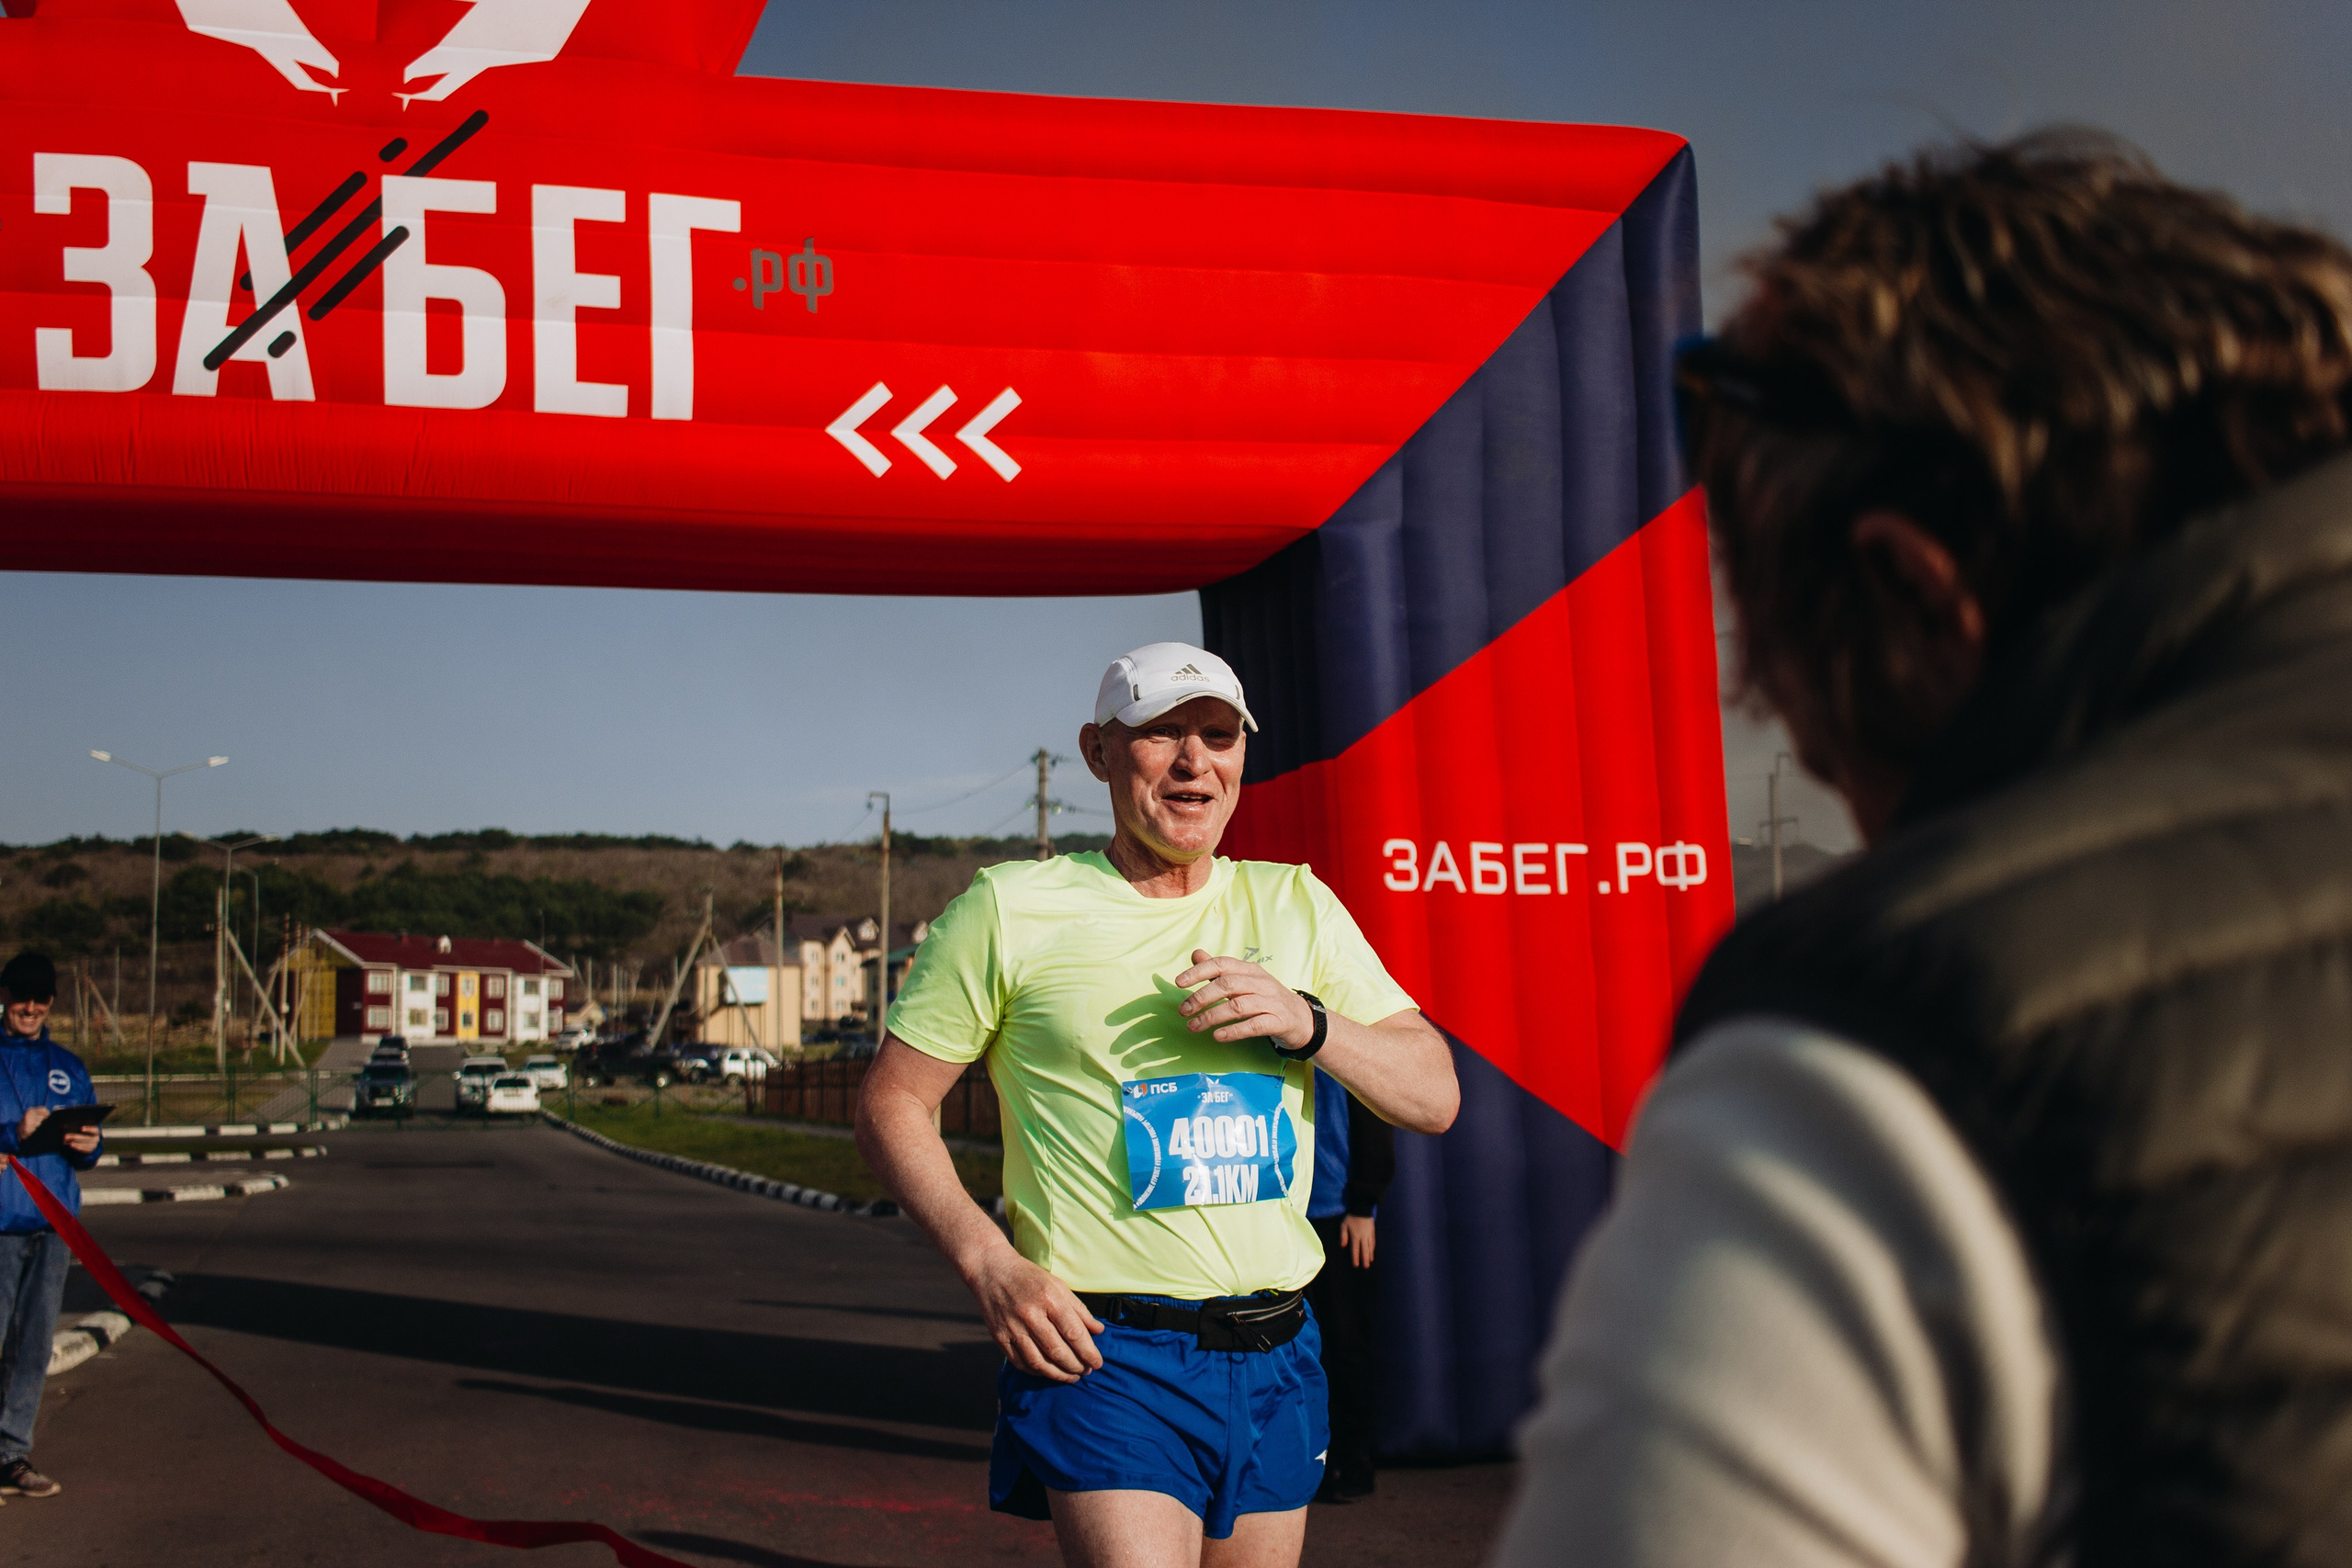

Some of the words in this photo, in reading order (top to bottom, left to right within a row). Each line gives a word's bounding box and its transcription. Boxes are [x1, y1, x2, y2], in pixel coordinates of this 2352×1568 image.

[1170, 672, 1210, 682] adidas
[1382, 838, 1708, 896] ЗАБЕГ.РФ
[1150, 1082, 1179, 1095] ПСБ
[1169, 1114, 1270, 1160] 40001
